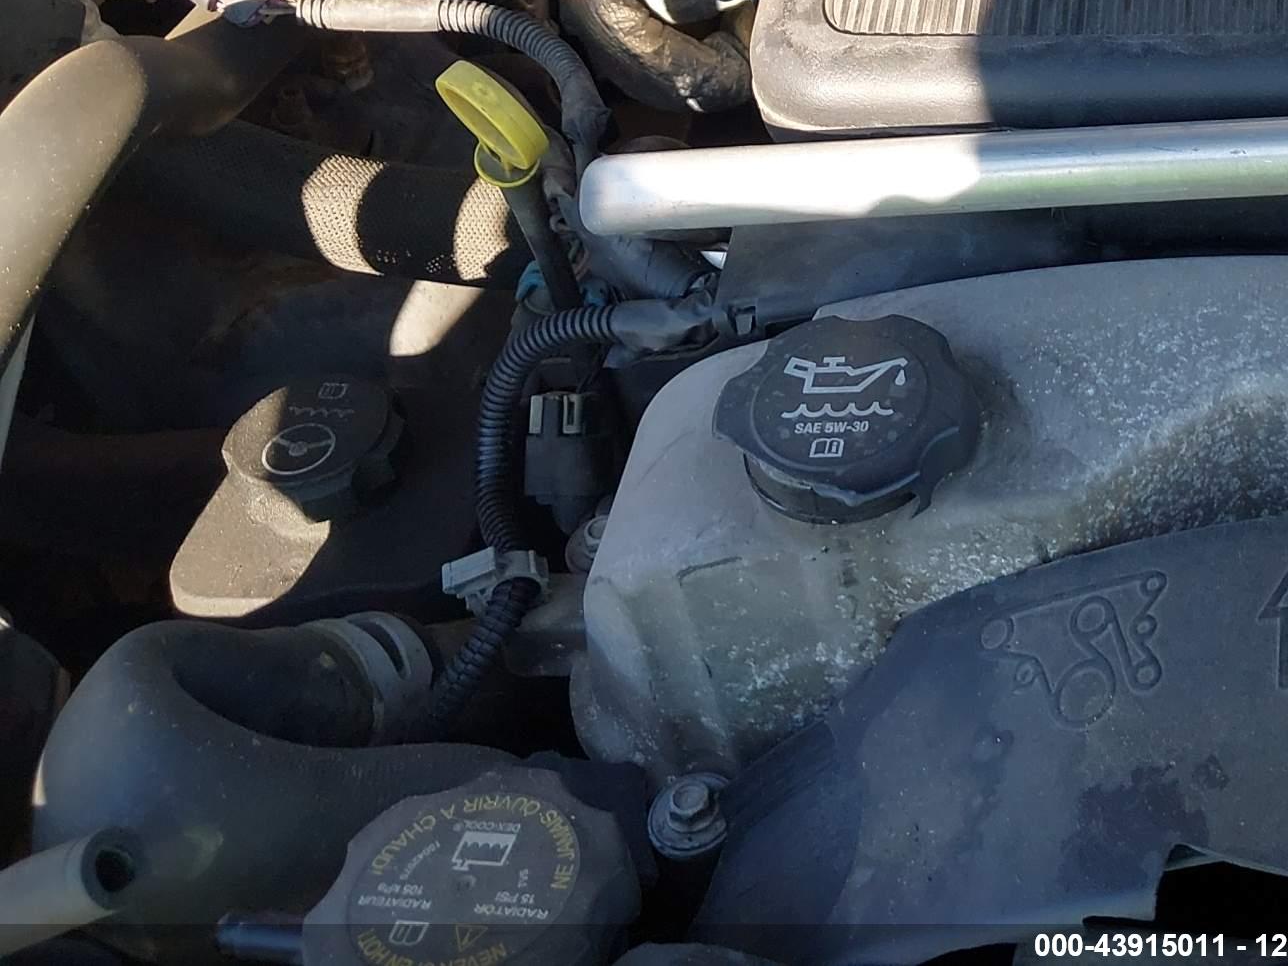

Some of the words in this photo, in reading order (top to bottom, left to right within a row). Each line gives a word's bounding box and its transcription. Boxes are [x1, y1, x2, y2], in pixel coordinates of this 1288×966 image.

[794, 422, 821, 434] SAE
[824, 420, 869, 434] 5W-30
[464, 794, 541, 817] OUVRIR
[549, 862, 575, 890] NE
[357, 894, 433, 910] RADIATEUR
[473, 902, 550, 919] RADIATOR
